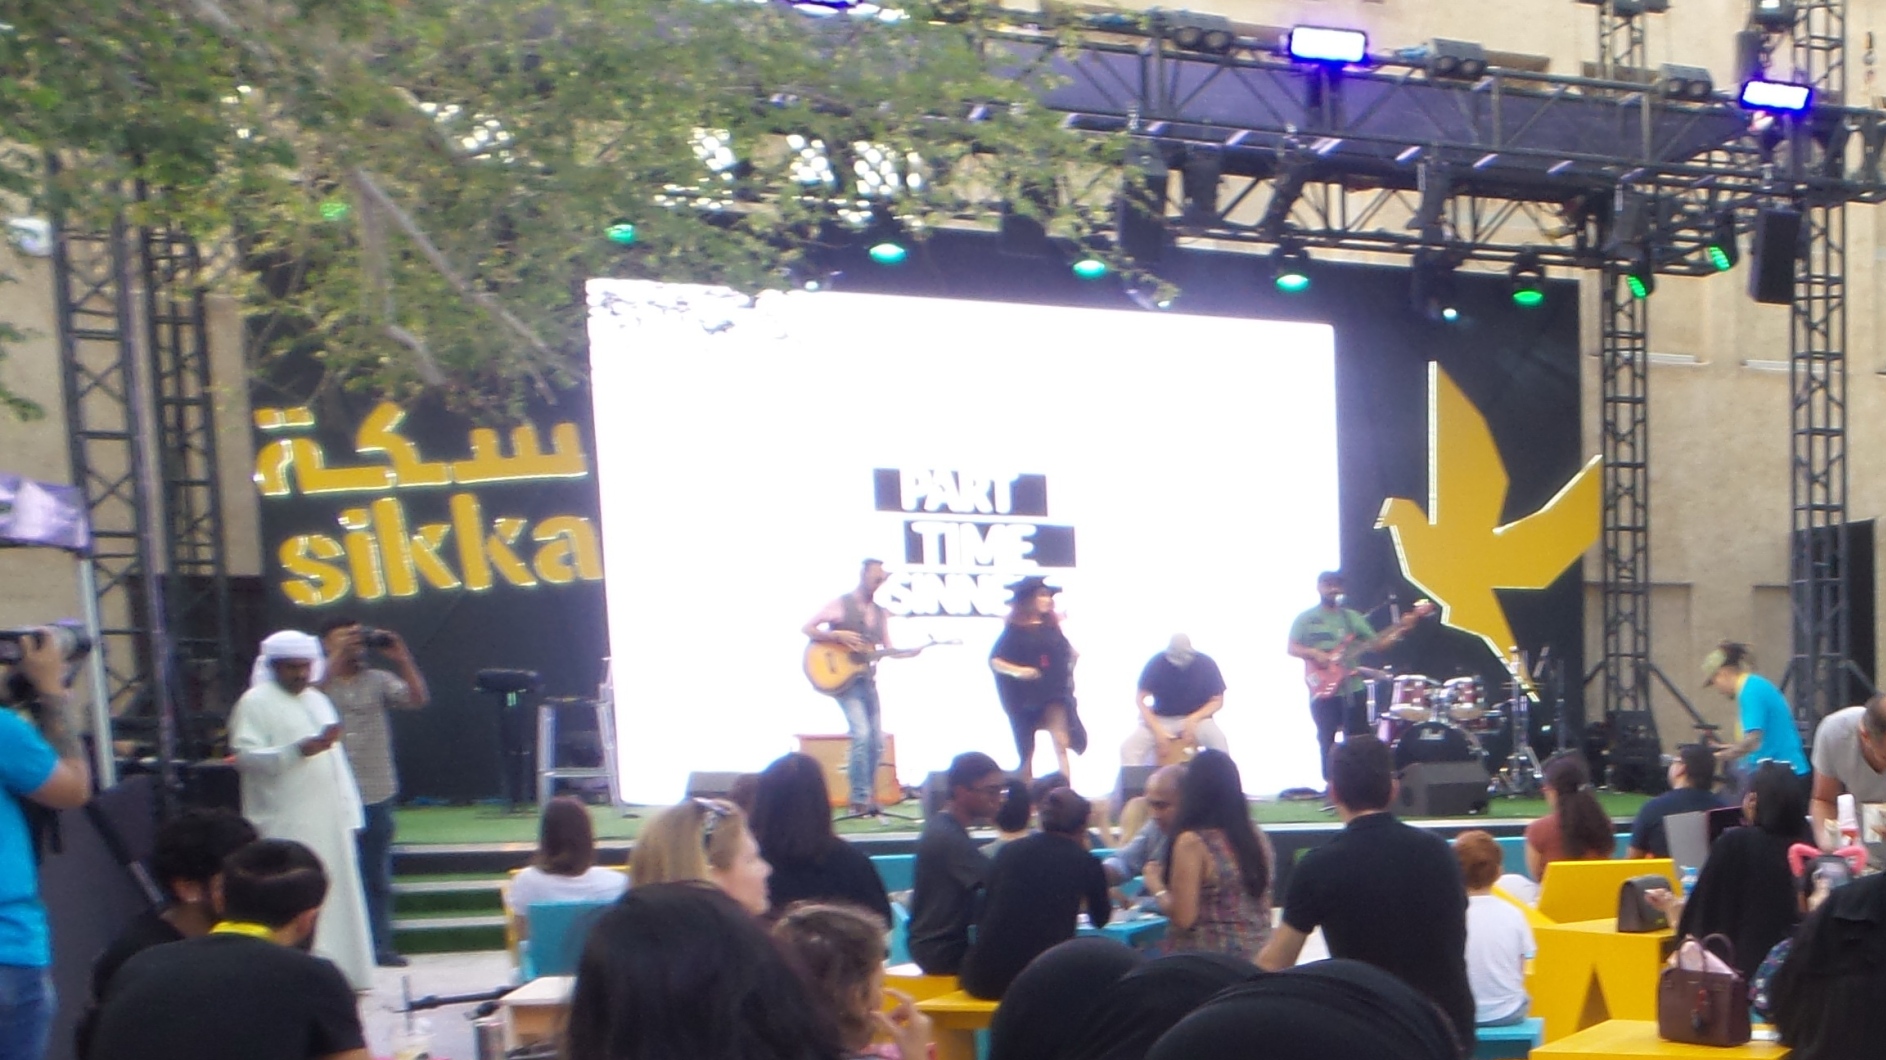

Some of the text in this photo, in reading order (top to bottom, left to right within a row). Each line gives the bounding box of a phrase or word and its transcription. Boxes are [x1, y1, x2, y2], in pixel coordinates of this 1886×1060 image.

[252, 402, 588, 496] سكة
[900, 469, 1019, 513] PART
[278, 493, 603, 606] sikka
[910, 521, 1039, 566] TIME
